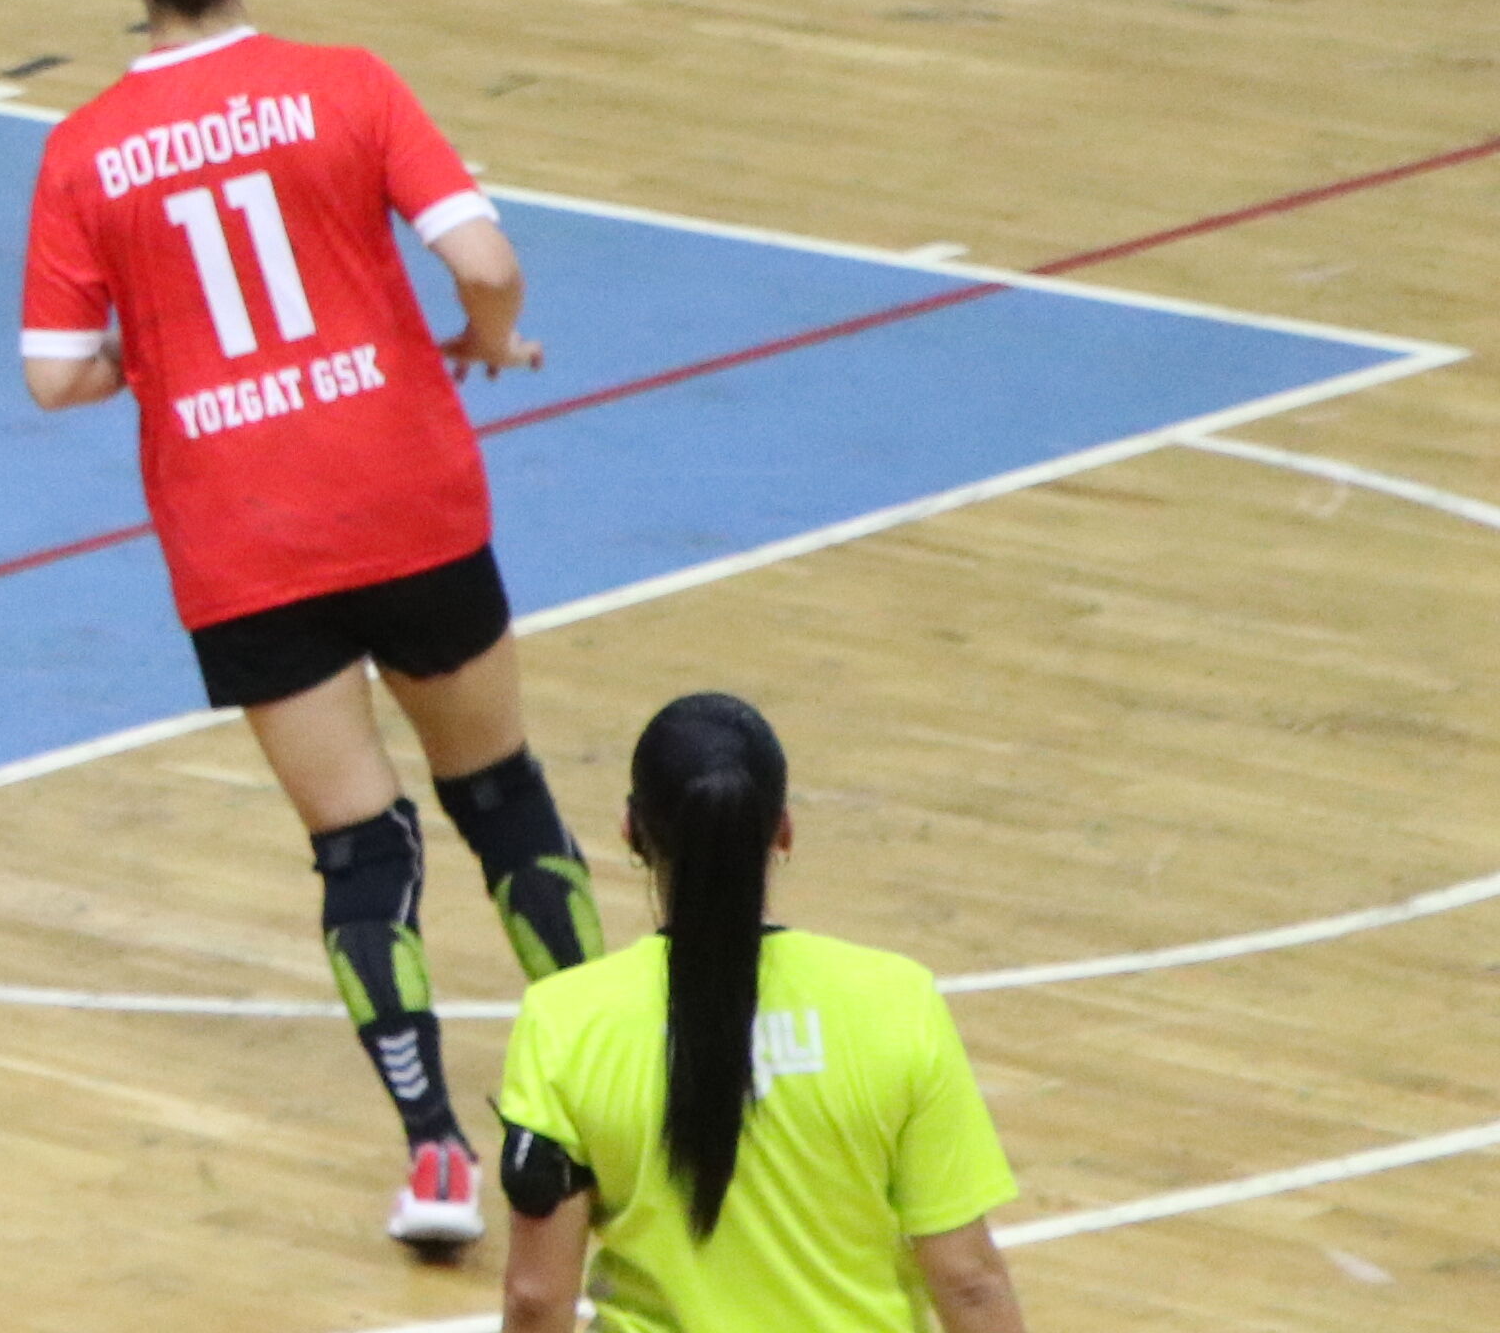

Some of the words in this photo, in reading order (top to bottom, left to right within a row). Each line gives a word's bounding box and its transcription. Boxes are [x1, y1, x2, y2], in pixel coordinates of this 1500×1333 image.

[94, 93, 317, 200] BOZDOĞAN
[163, 169, 318, 360] 11
[174, 365, 306, 441] YOZGAT
[308, 342, 388, 404] GSK
